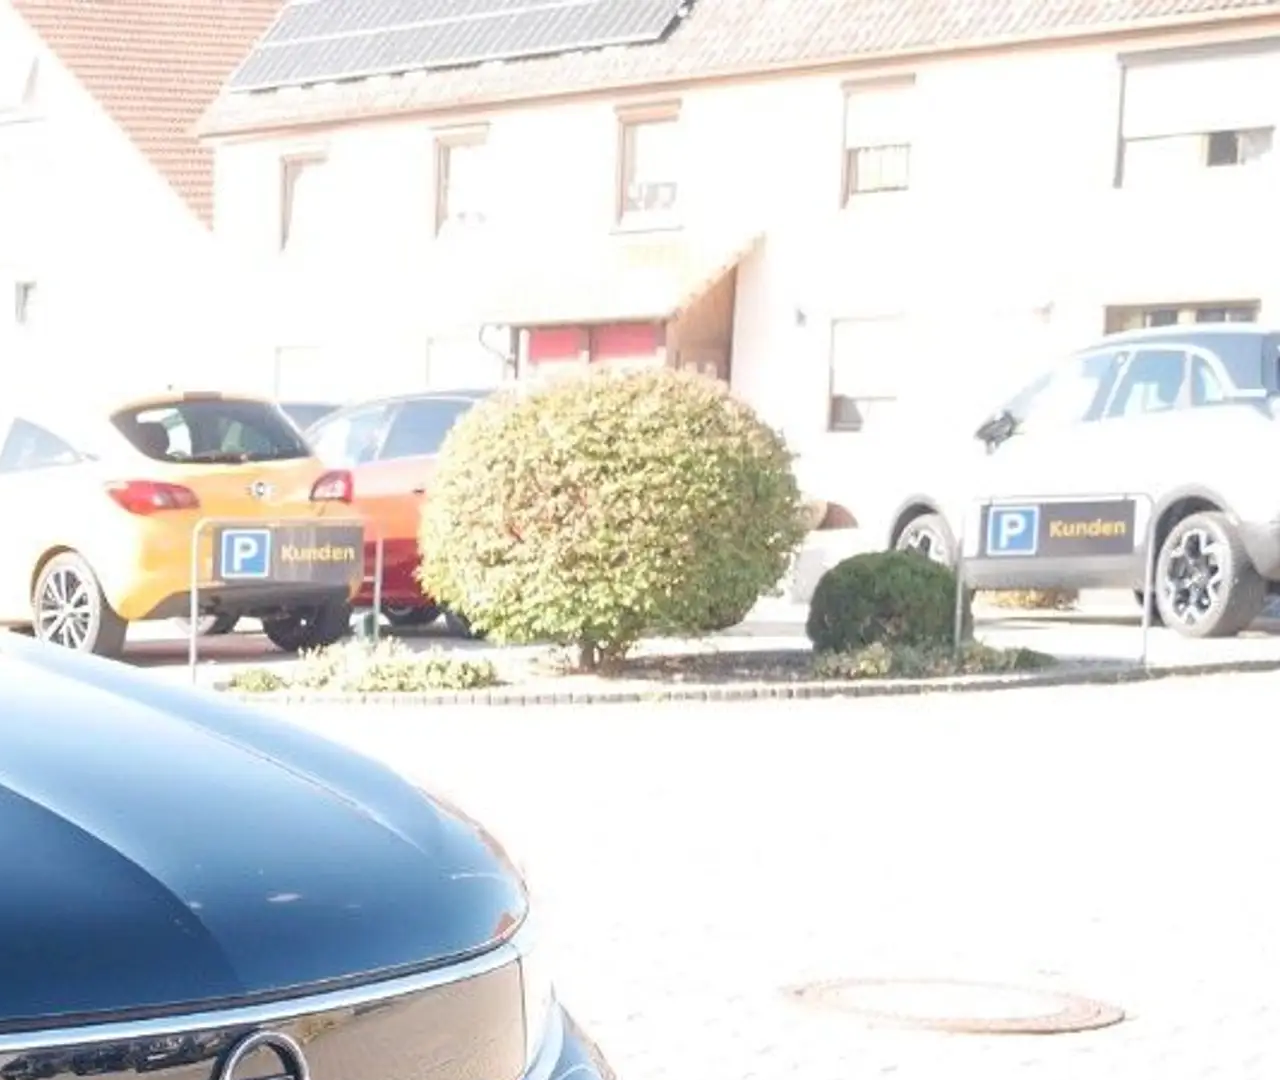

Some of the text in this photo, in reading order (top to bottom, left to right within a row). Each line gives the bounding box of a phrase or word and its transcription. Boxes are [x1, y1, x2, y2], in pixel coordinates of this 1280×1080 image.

[999, 513, 1126, 549] P Kunden
[233, 536, 355, 572] P Kunden
